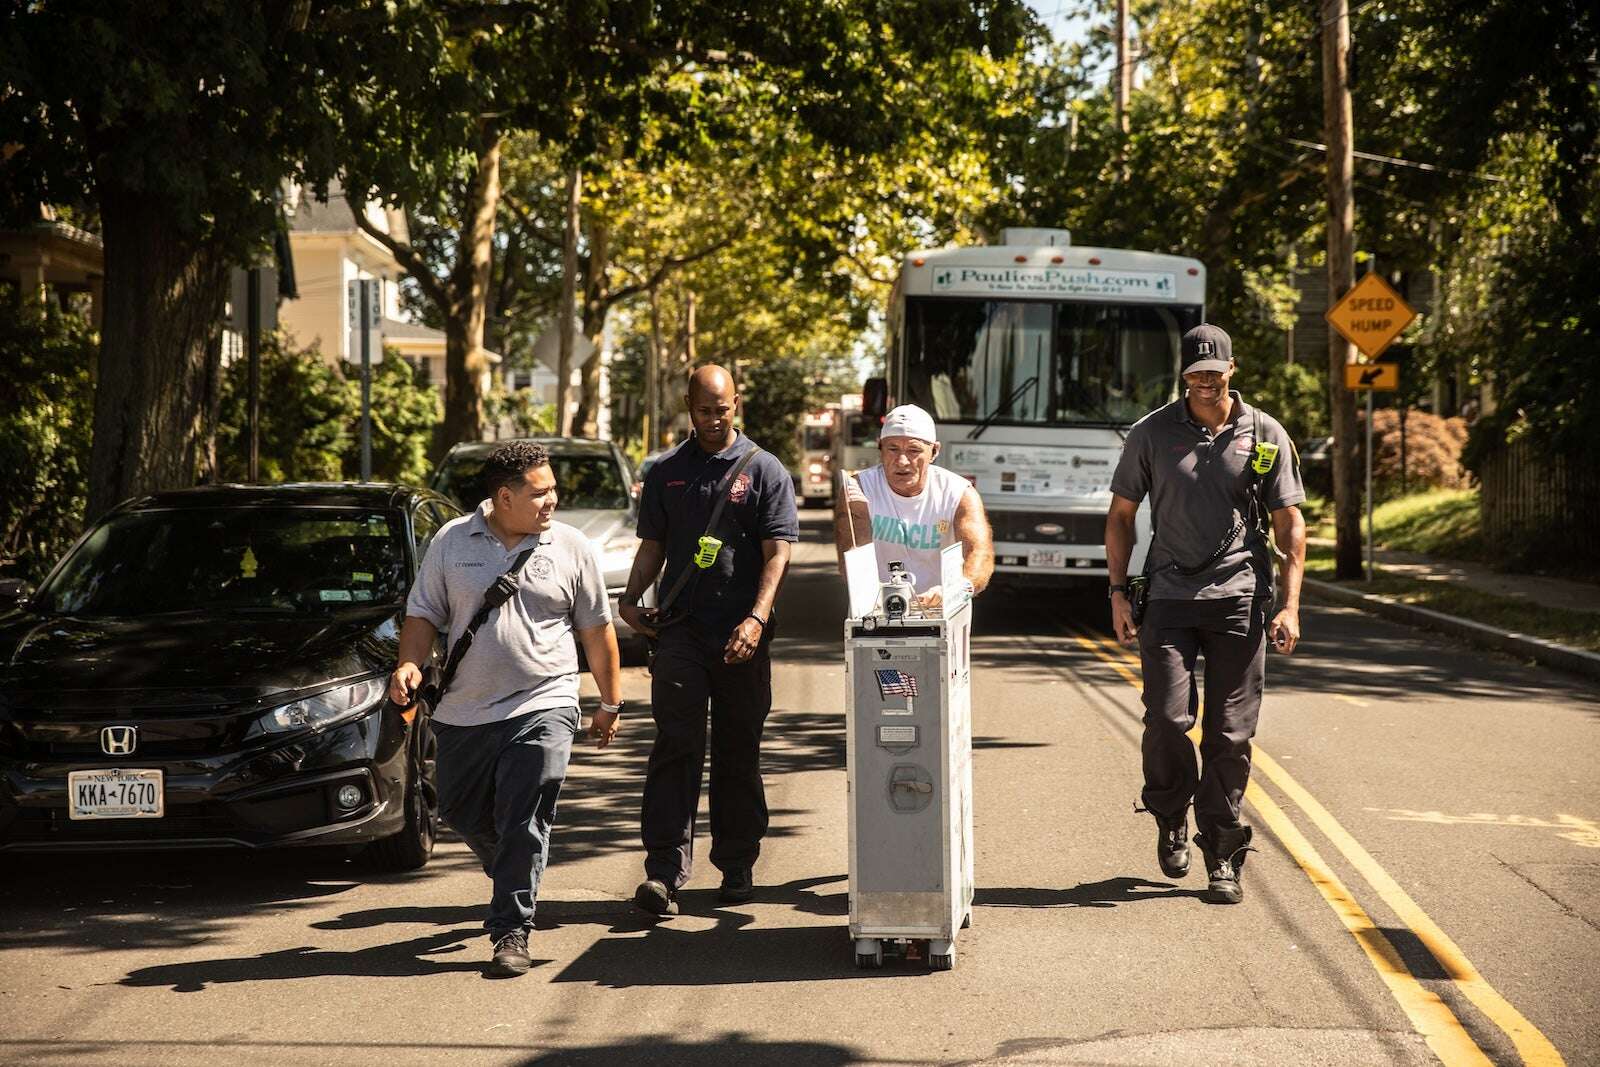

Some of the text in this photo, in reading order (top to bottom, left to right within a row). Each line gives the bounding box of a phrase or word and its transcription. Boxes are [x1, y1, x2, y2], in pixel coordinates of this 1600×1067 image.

[960, 269, 1149, 288] PauliesPush.com
[1349, 298, 1395, 312] SPEED
[1350, 319, 1393, 332] HUMP
[94, 775, 113, 783] NEW
[79, 783, 155, 806] KKA 7670
